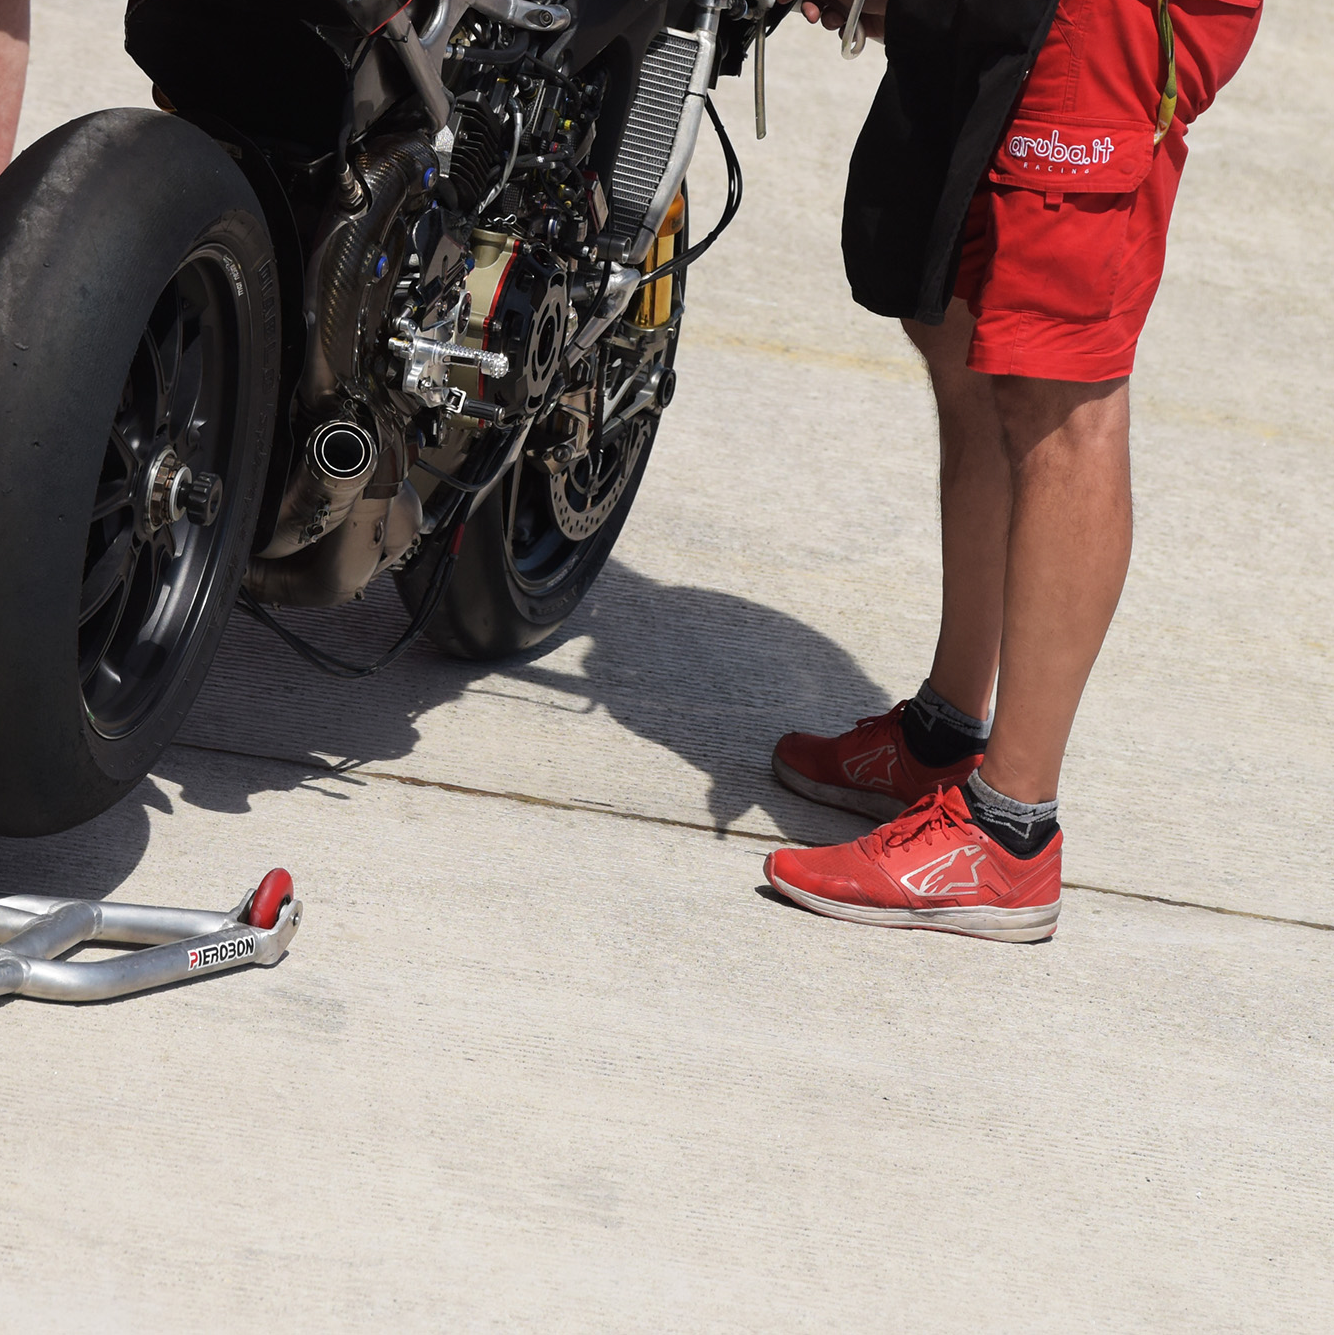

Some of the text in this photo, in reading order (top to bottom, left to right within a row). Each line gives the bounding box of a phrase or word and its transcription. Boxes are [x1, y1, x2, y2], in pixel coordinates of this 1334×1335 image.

[1009, 129, 1115, 165] aruba.it
[1023, 161, 1090, 175] RACING
[189, 937, 255, 969] PIEROBON
